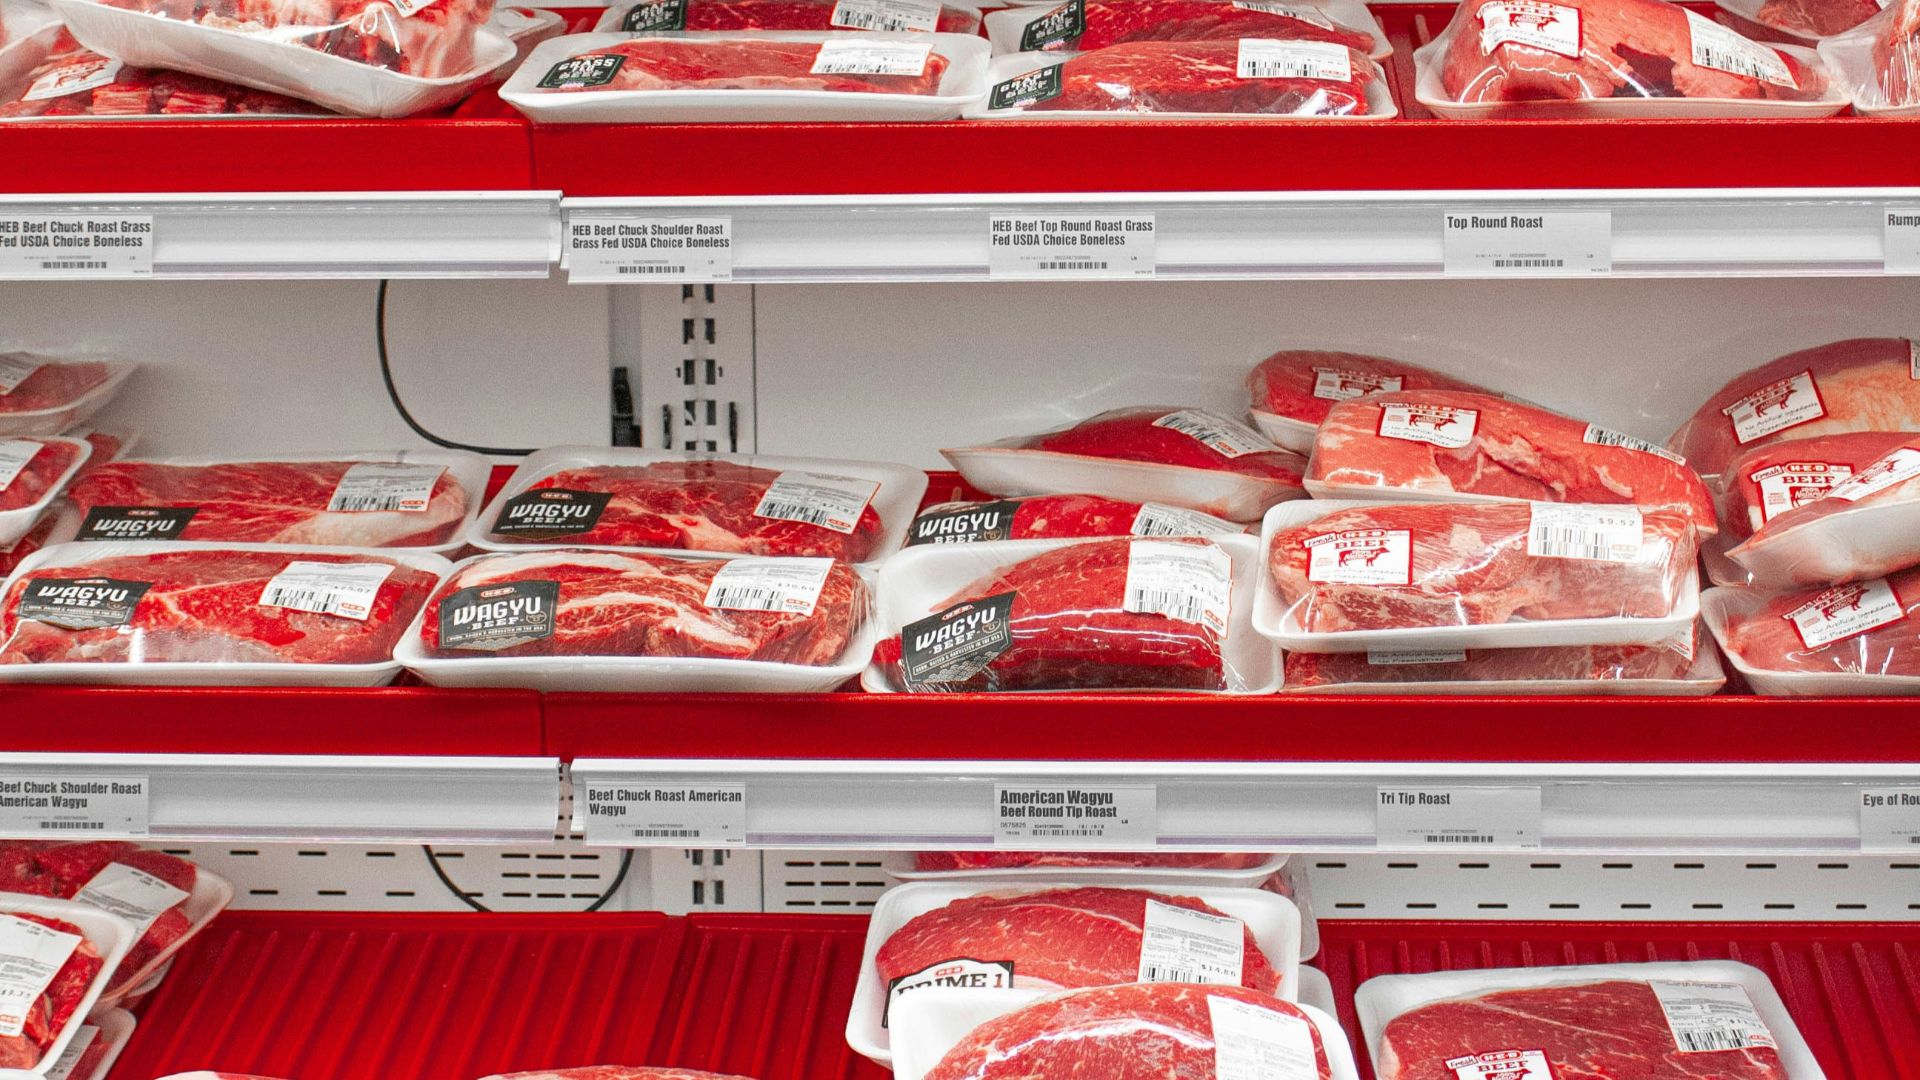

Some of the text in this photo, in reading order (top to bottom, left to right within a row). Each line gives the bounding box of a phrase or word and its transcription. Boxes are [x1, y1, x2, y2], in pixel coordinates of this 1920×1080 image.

[0, 221, 151, 233] HEB Beef Chuck Roast Grass
[992, 220, 1153, 233] HEB Beef Top Round Roast Grass
[1447, 216, 1543, 230] Top Round Roast
[1888, 214, 1920, 227] Rump
[572, 224, 723, 236] HEB Beef Chuck Shoulder Roast
[0, 235, 143, 247] Fed USDA Choice Boneless
[572, 237, 730, 249] Grass Fed USDA Choice Boneless
[992, 234, 1125, 246] Fed USDA Choice Boneless
[1782, 475, 1835, 484] BEEF
[509, 504, 591, 519] WAGYU
[93, 519, 176, 532] WAGYU
[918, 511, 1000, 538] WAGYU
[934, 533, 978, 544] BEEF
[1334, 539, 1391, 549] BEEF
[37, 585, 128, 602] WAGYU
[52, 597, 100, 607] BEEF
[453, 596, 541, 626] WAGYU
[471, 617, 520, 630] BEEF
[915, 607, 996, 652] WAGYU
[932, 630, 976, 654] BEEF
[0, 782, 142, 794] Beef Chuck Shoulder Roast
[589, 789, 742, 802] Beef Chuck Roast American
[1000, 790, 1113, 805] American Wagyu
[1380, 792, 1450, 806] Tri Tip Roast
[1863, 794, 1884, 807] Eye
[1887, 793, 1898, 806] of
[0, 796, 88, 809] American Wagyu
[589, 803, 626, 816] Wagyu
[1000, 806, 1117, 819] Beef Round Tip Roast
[993, 973, 1003, 988] 1
[1478, 1061, 1528, 1072] BEEF
